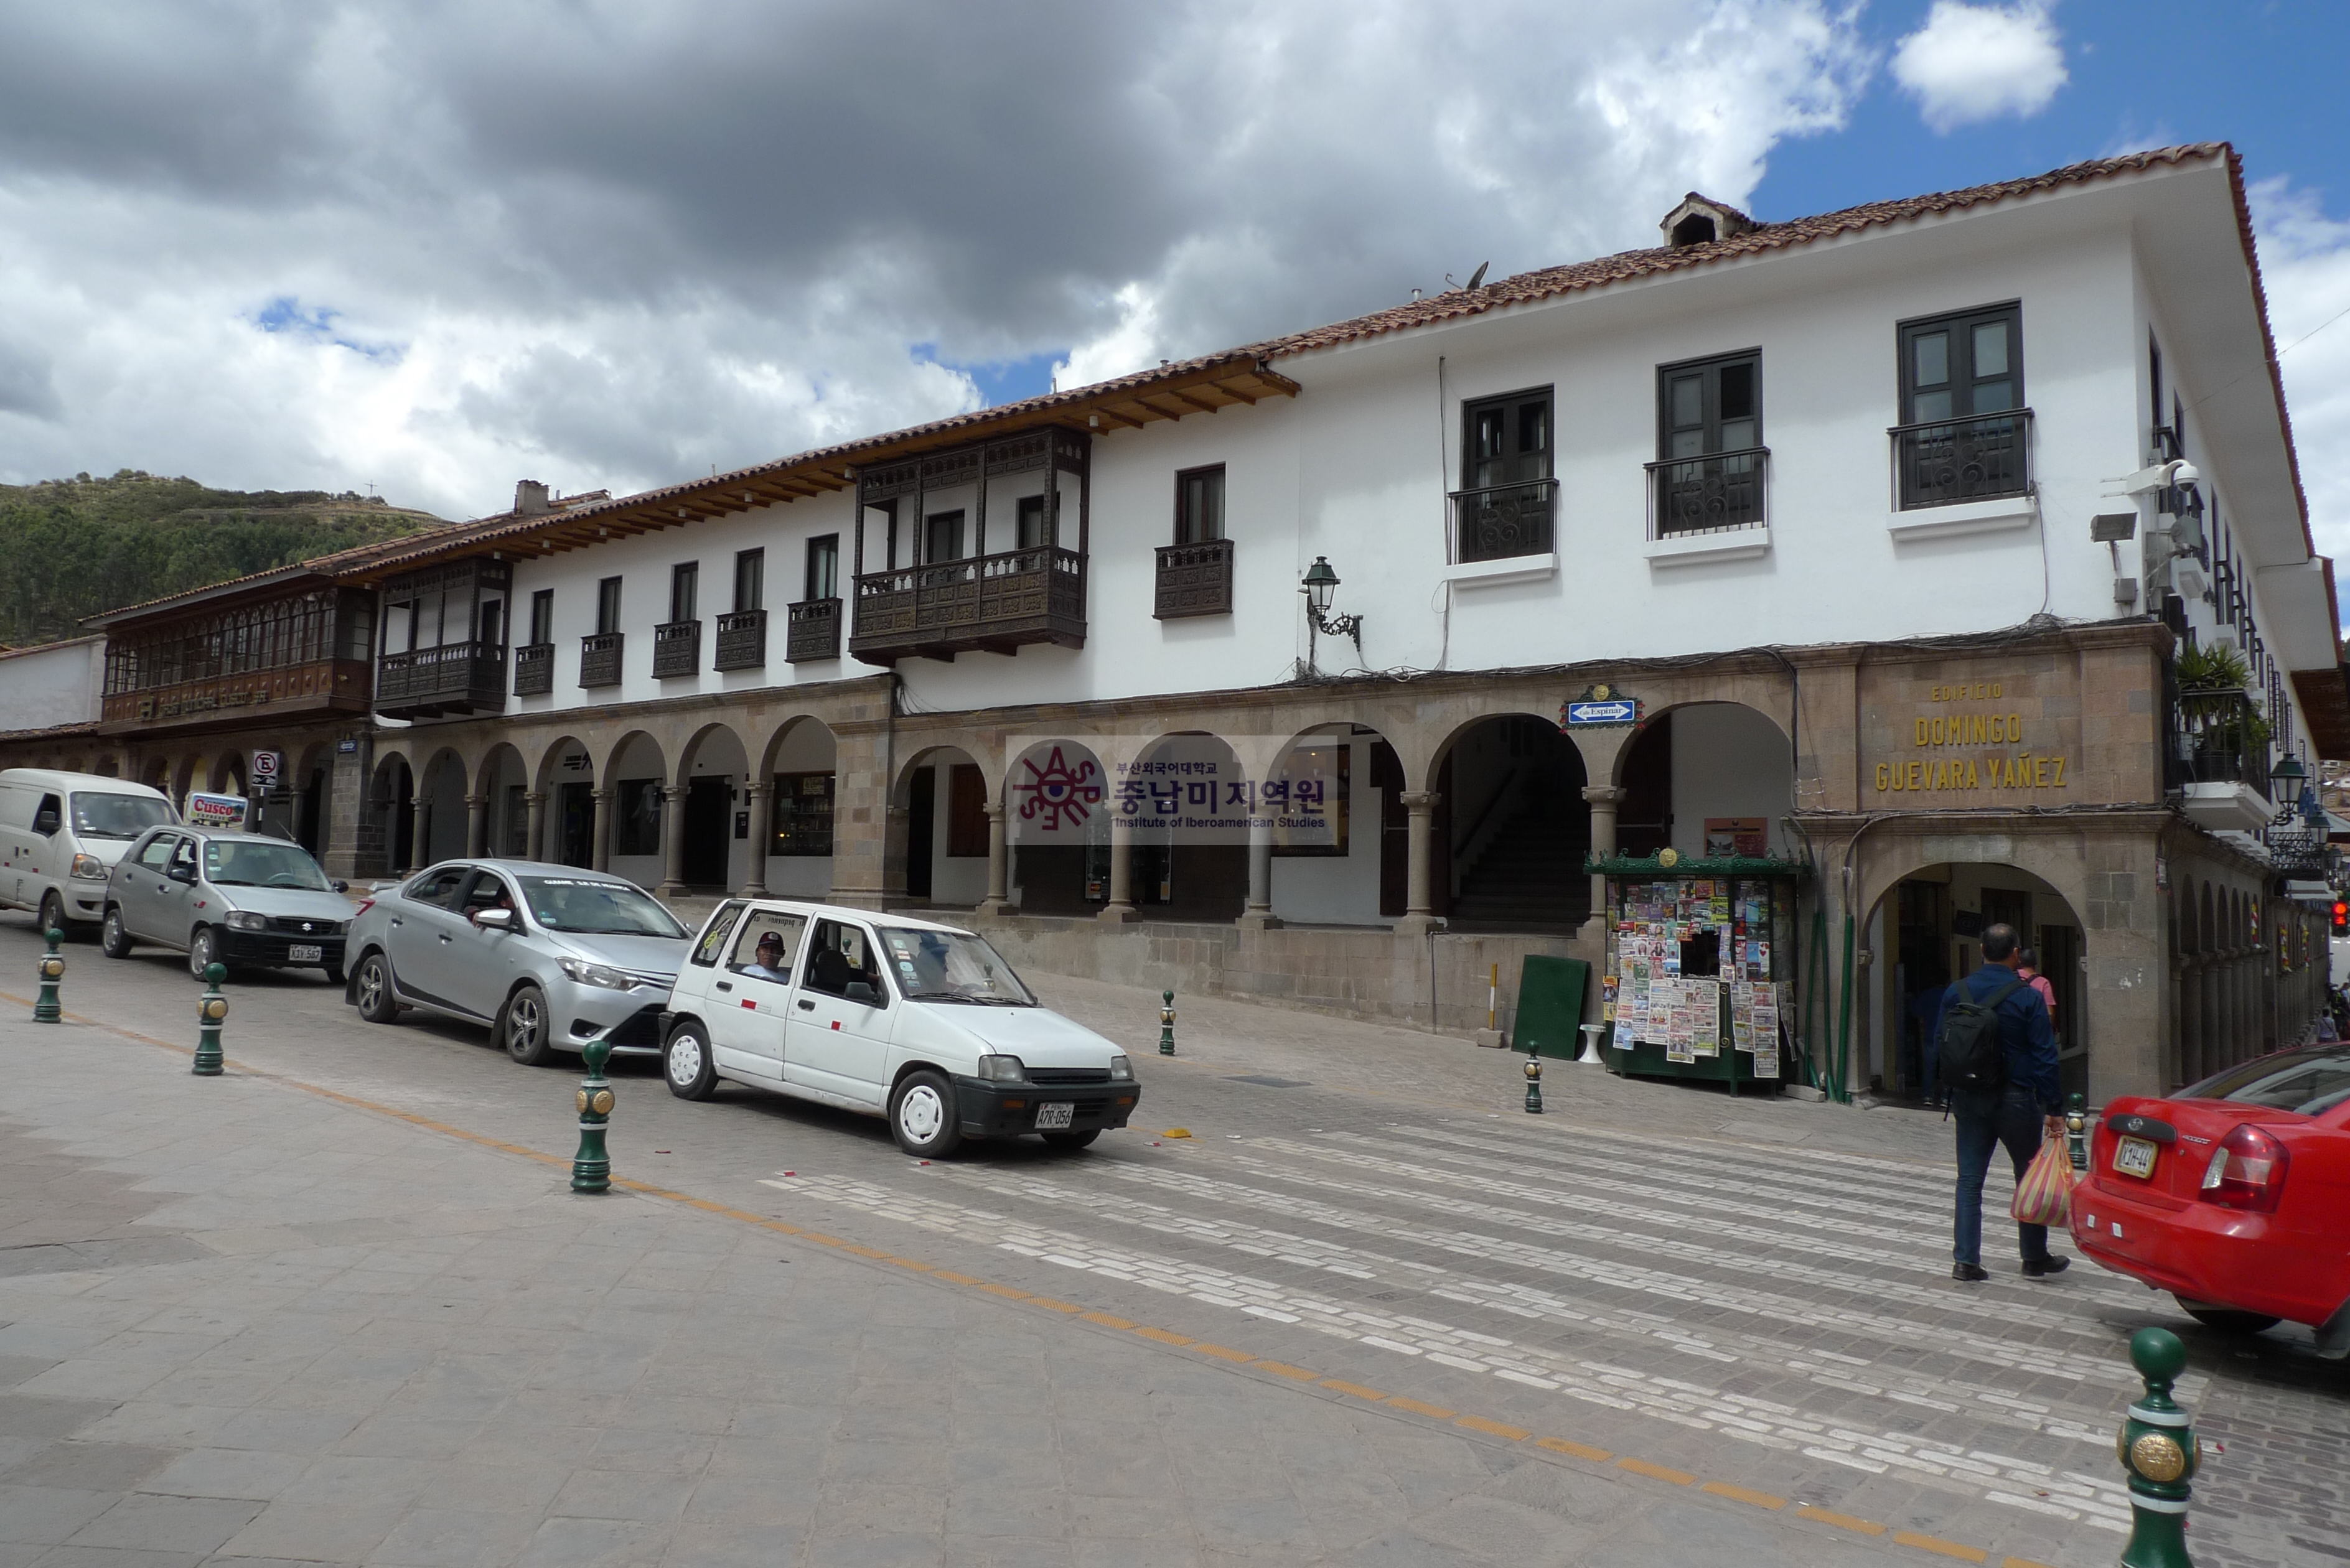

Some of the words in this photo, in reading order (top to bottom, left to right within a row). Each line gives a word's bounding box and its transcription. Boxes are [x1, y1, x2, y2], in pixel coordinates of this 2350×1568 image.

[1931, 683, 2002, 702] EDIFICIO
[1591, 707, 1623, 717] Espinar
[1915, 713, 2021, 747] DOMINGO
[1875, 759, 1978, 791] GUEVARA
[1988, 752, 2067, 788] YAÑEZ
[194, 799, 233, 816] Cusco
[1037, 1110, 1071, 1124] A7R-056
